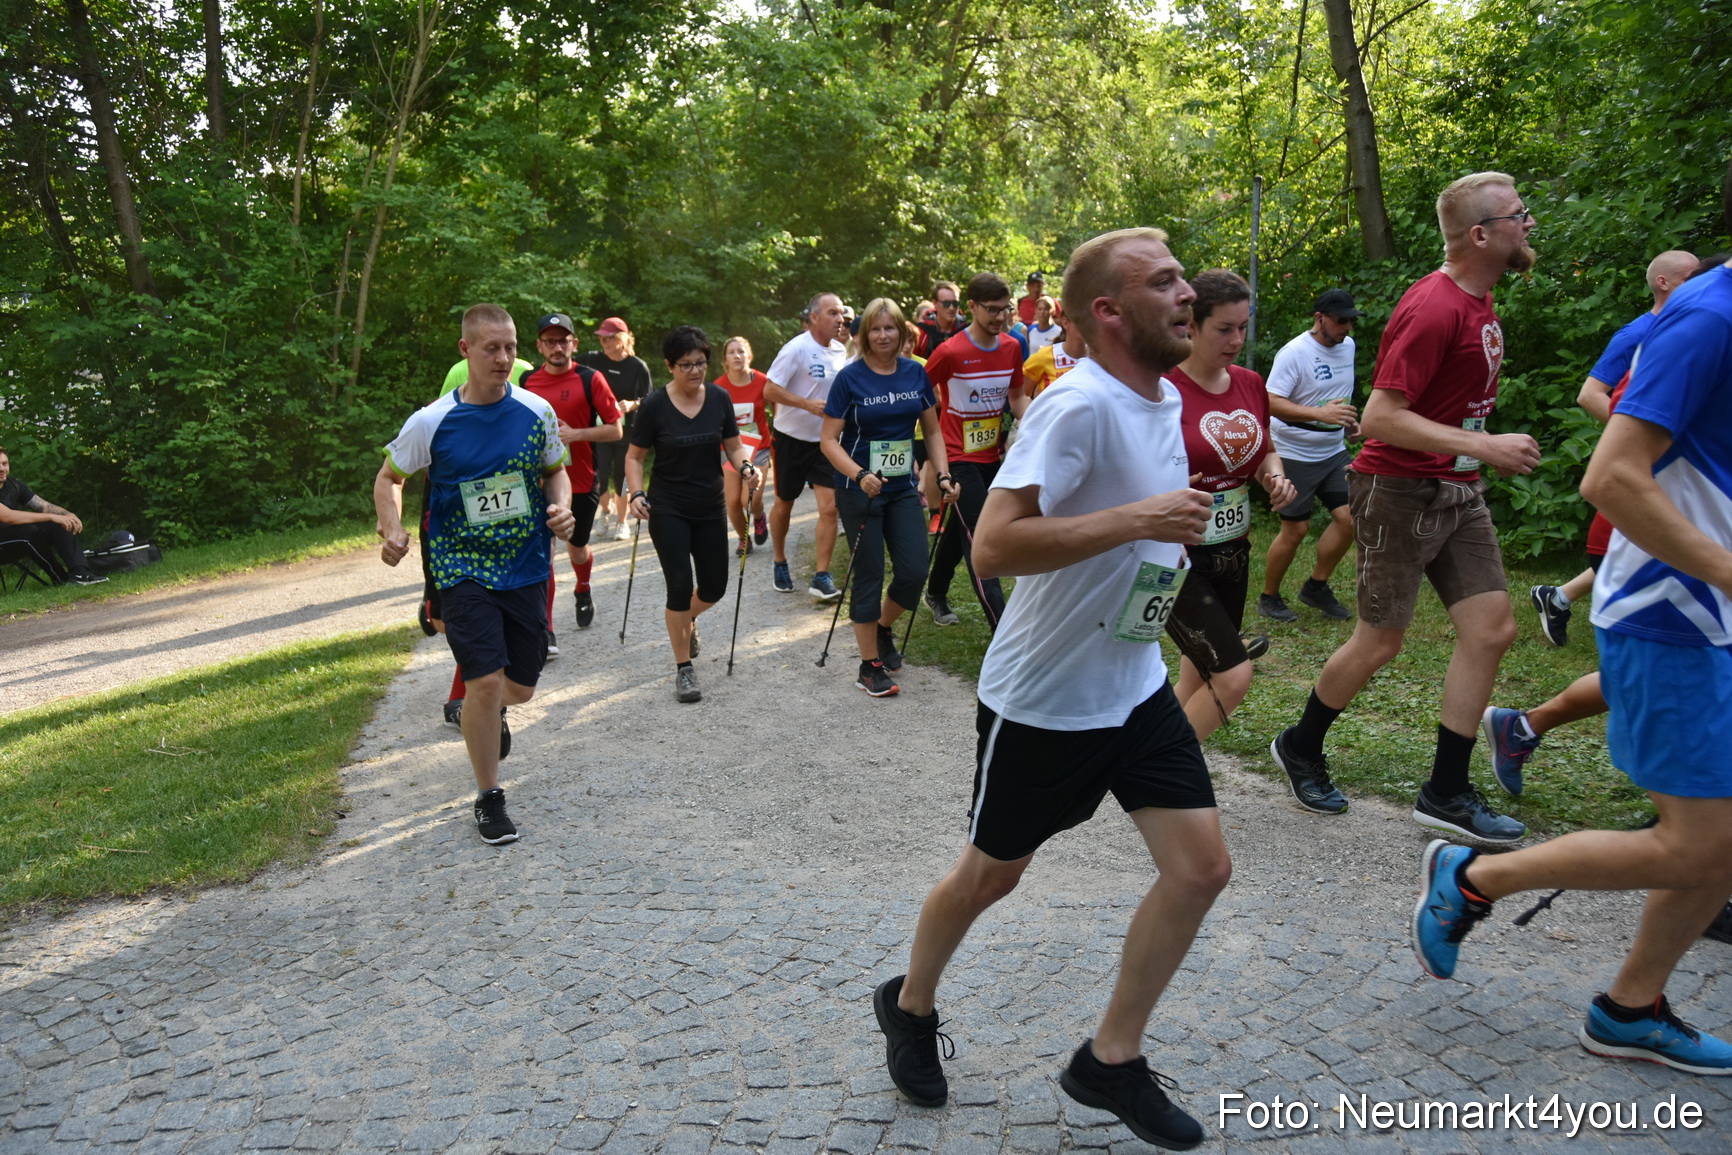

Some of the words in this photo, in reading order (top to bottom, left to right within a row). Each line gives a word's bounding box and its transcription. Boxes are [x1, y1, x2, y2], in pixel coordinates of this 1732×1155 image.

[863, 394, 889, 406] EURO
[895, 390, 919, 402] POLES
[969, 428, 996, 444] 1835
[1223, 430, 1248, 440] Alexa
[880, 453, 906, 467] 706
[477, 490, 512, 513] 217
[1214, 504, 1244, 529] 695
